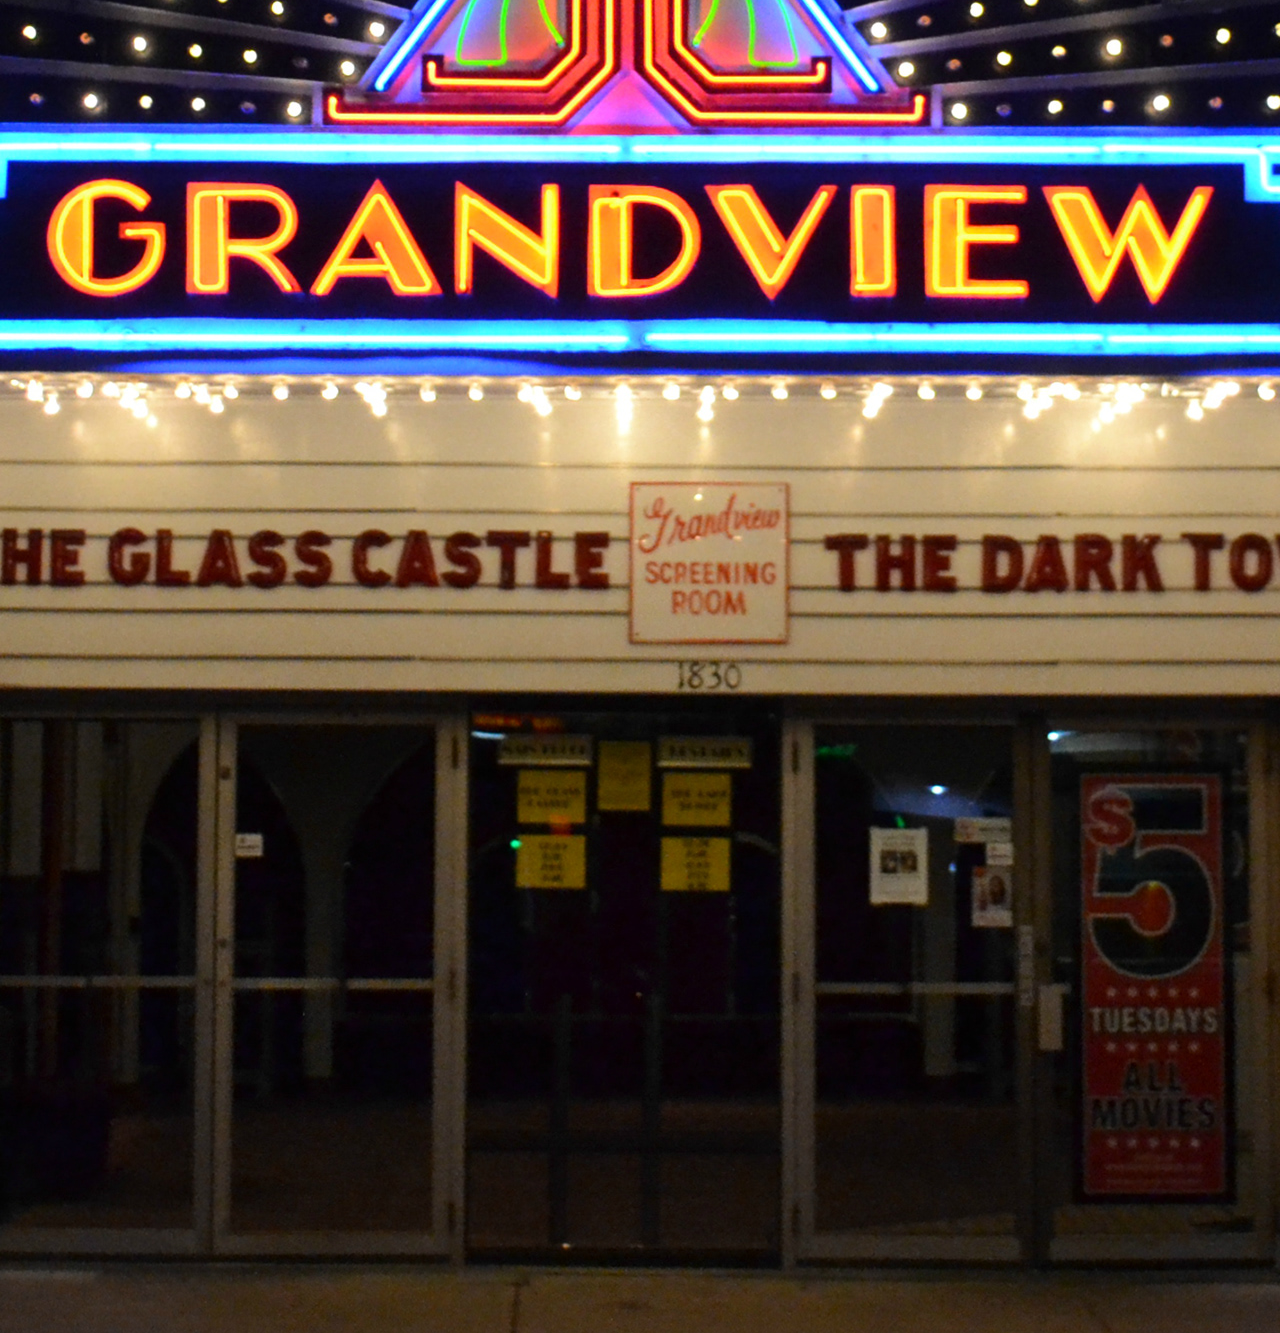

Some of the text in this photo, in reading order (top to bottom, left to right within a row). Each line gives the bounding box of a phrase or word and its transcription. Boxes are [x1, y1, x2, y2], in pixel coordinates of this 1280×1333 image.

[46, 177, 1214, 304] GRANDVIEW
[638, 492, 781, 554] Grandview
[107, 528, 332, 589] GLASS
[351, 529, 610, 590] CASTLE
[645, 561, 777, 584] SCREENING
[824, 532, 958, 593] THE
[981, 533, 1166, 594] DARK
[671, 589, 747, 615] ROOM
[677, 661, 742, 689] 1830
[1089, 1006, 1218, 1034] TUESDAYS
[1125, 1061, 1183, 1092] ALL
[1092, 1097, 1216, 1128] MOVIES
